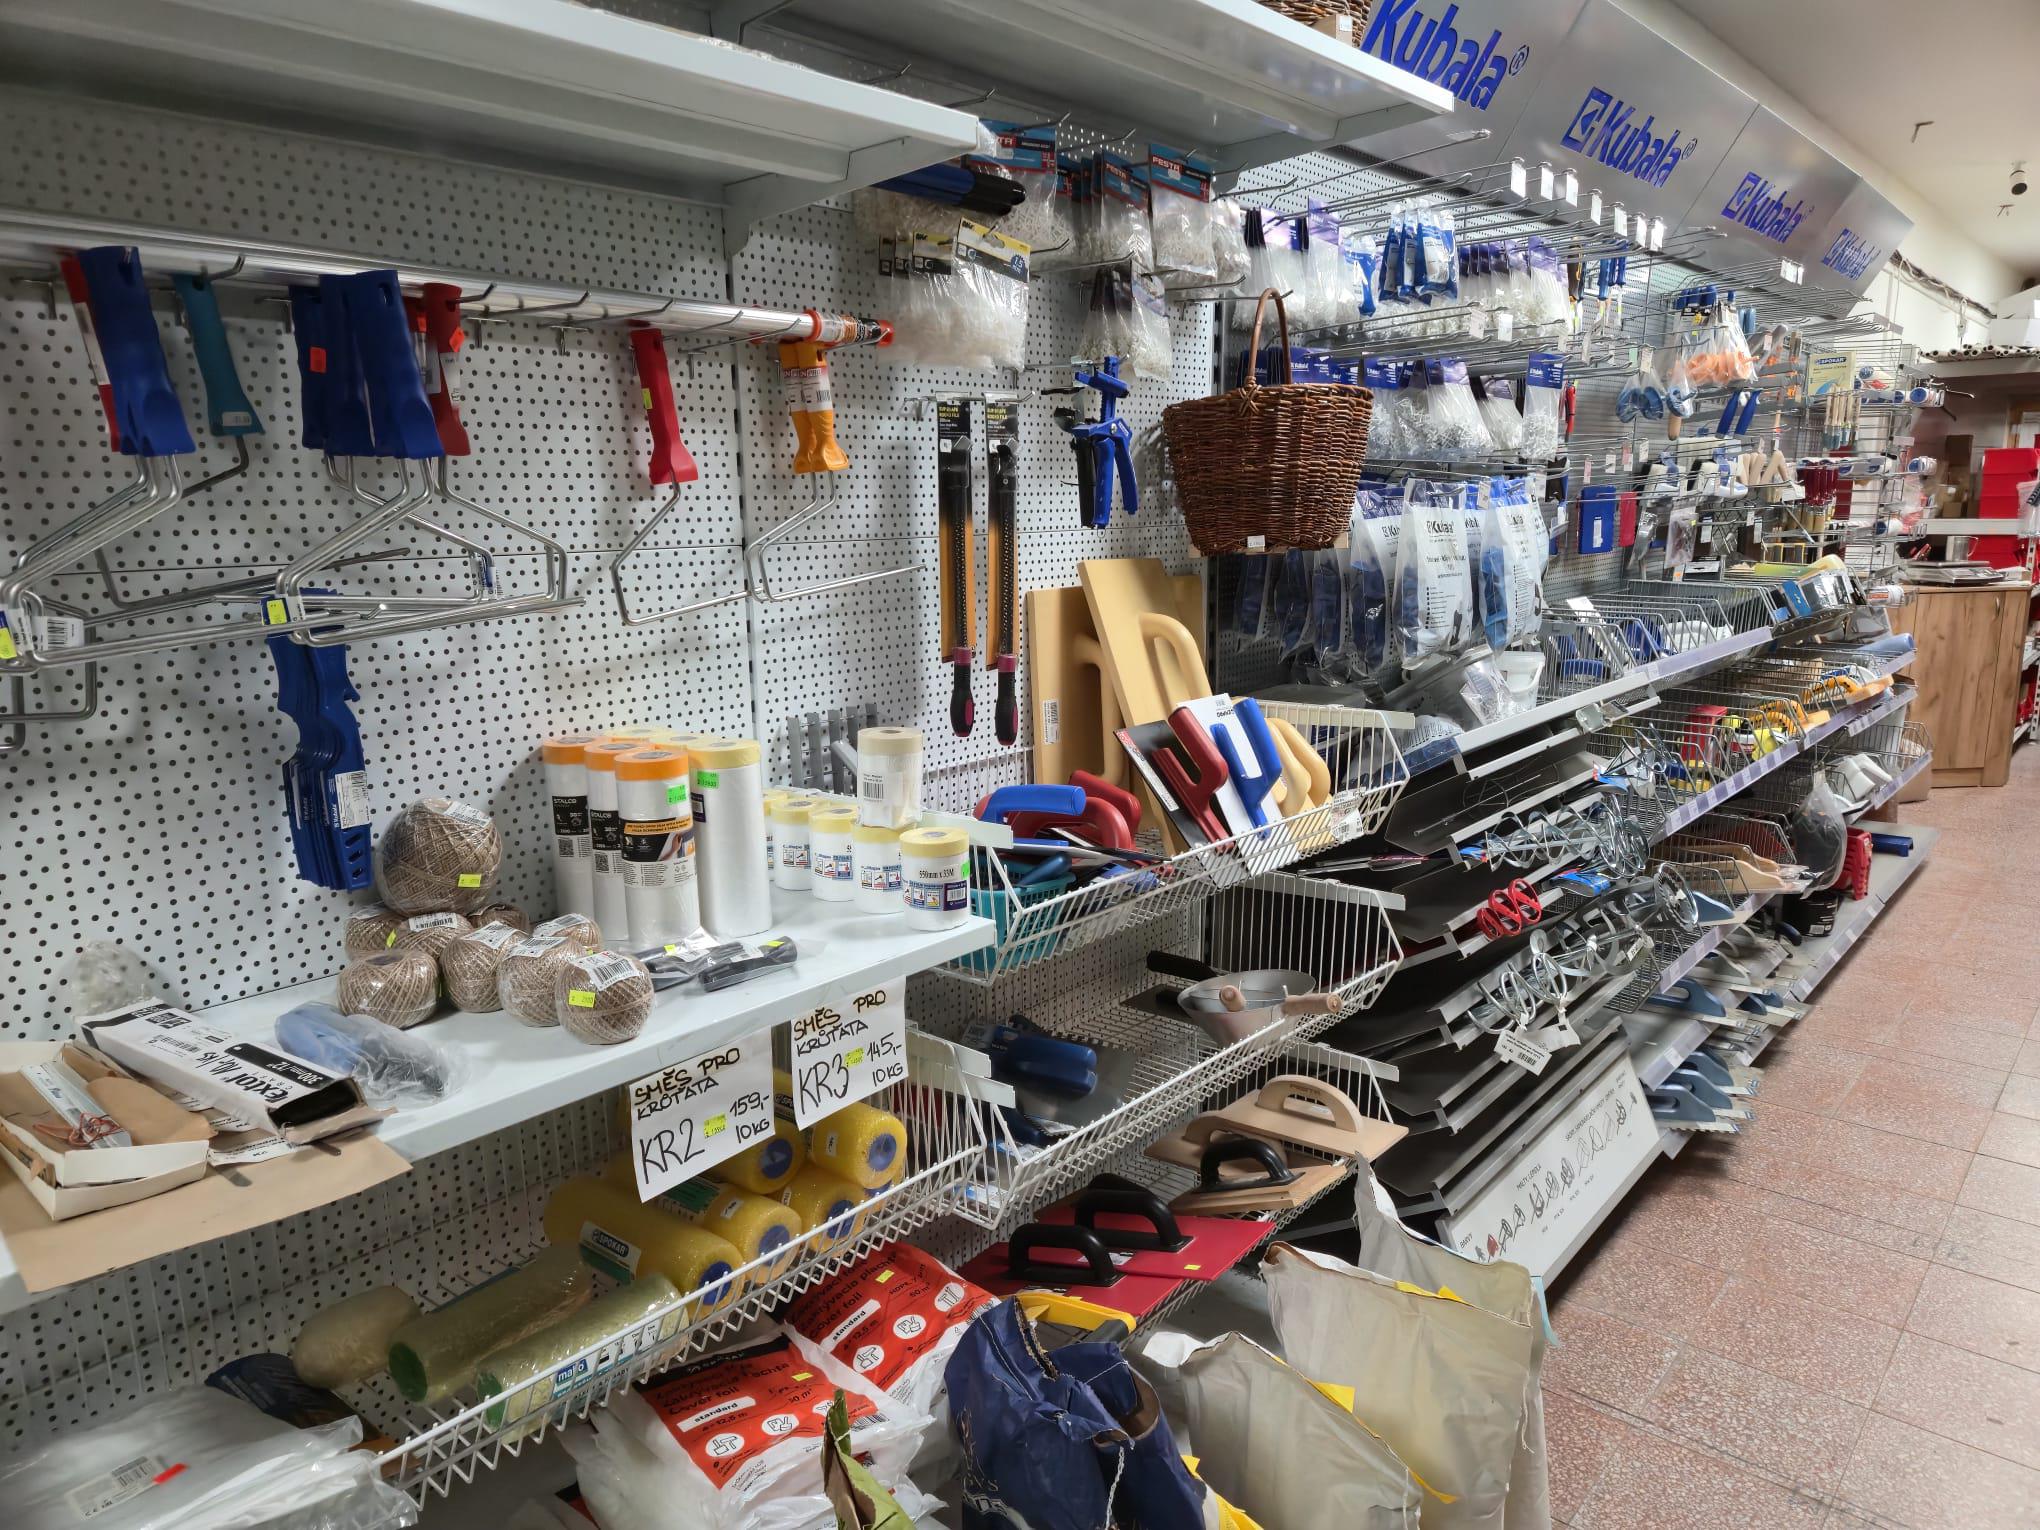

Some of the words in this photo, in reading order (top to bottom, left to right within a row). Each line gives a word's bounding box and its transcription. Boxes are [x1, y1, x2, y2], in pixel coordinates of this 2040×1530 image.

[1152, 155, 1180, 171] FESTA
[793, 1006, 841, 1041] SMĚS
[853, 990, 886, 1013] PRO
[634, 1068, 692, 1105] SMĚS
[697, 1047, 741, 1076] PRO
[798, 1053, 849, 1115] KR3
[639, 1118, 705, 1184] KR2
[600, 1233, 627, 1256] SPOKAR
[842, 1291, 863, 1311] foil
[832, 1310, 867, 1341] standard
[716, 1386, 739, 1399] foil
[694, 1402, 738, 1423] standard
